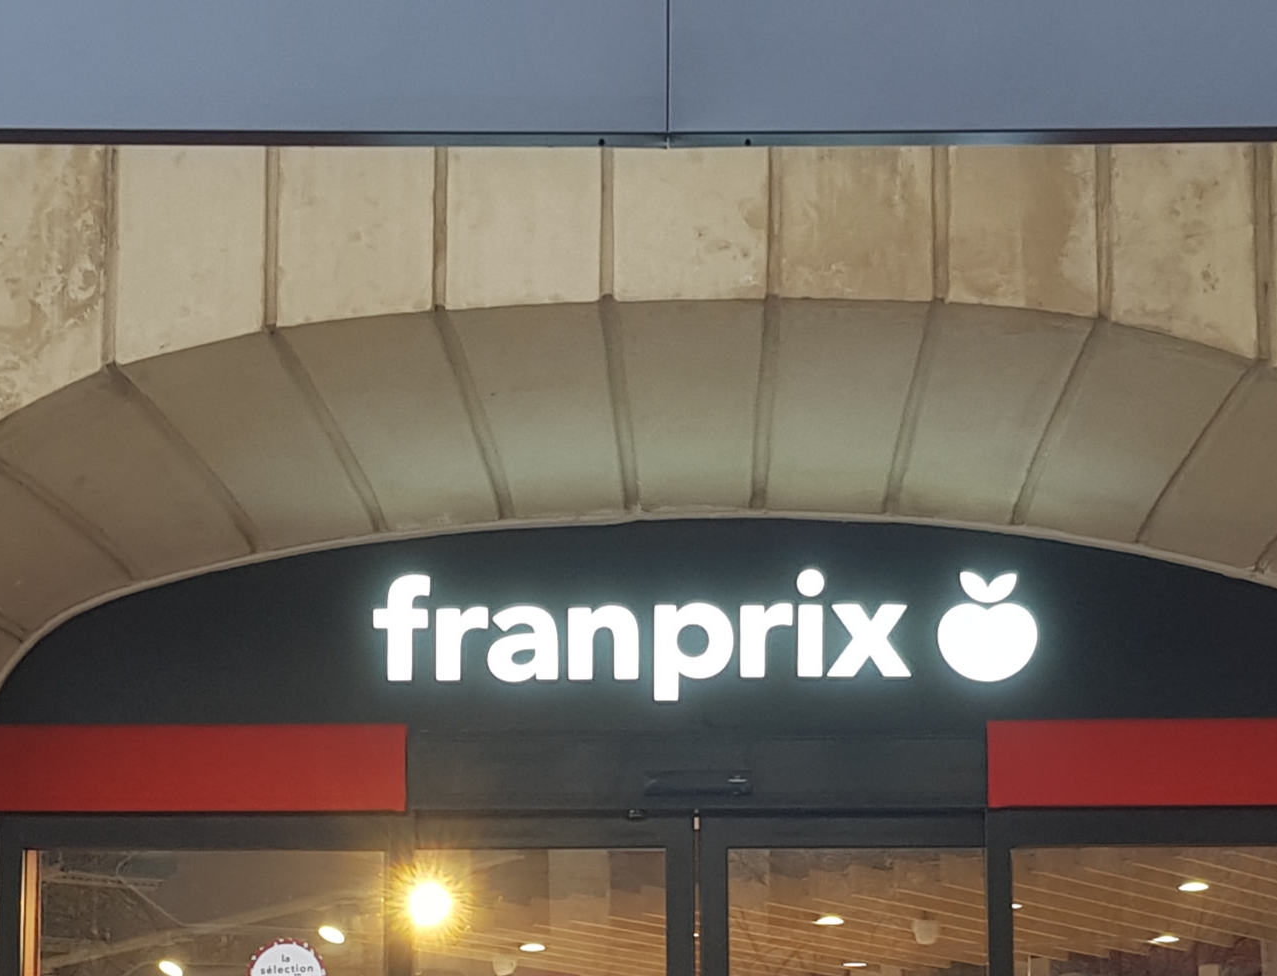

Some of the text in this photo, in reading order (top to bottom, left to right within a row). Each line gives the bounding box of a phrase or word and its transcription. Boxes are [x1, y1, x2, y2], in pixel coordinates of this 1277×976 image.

[372, 568, 912, 701] franprix
[281, 955, 290, 963] la
[260, 963, 314, 975] sélection
